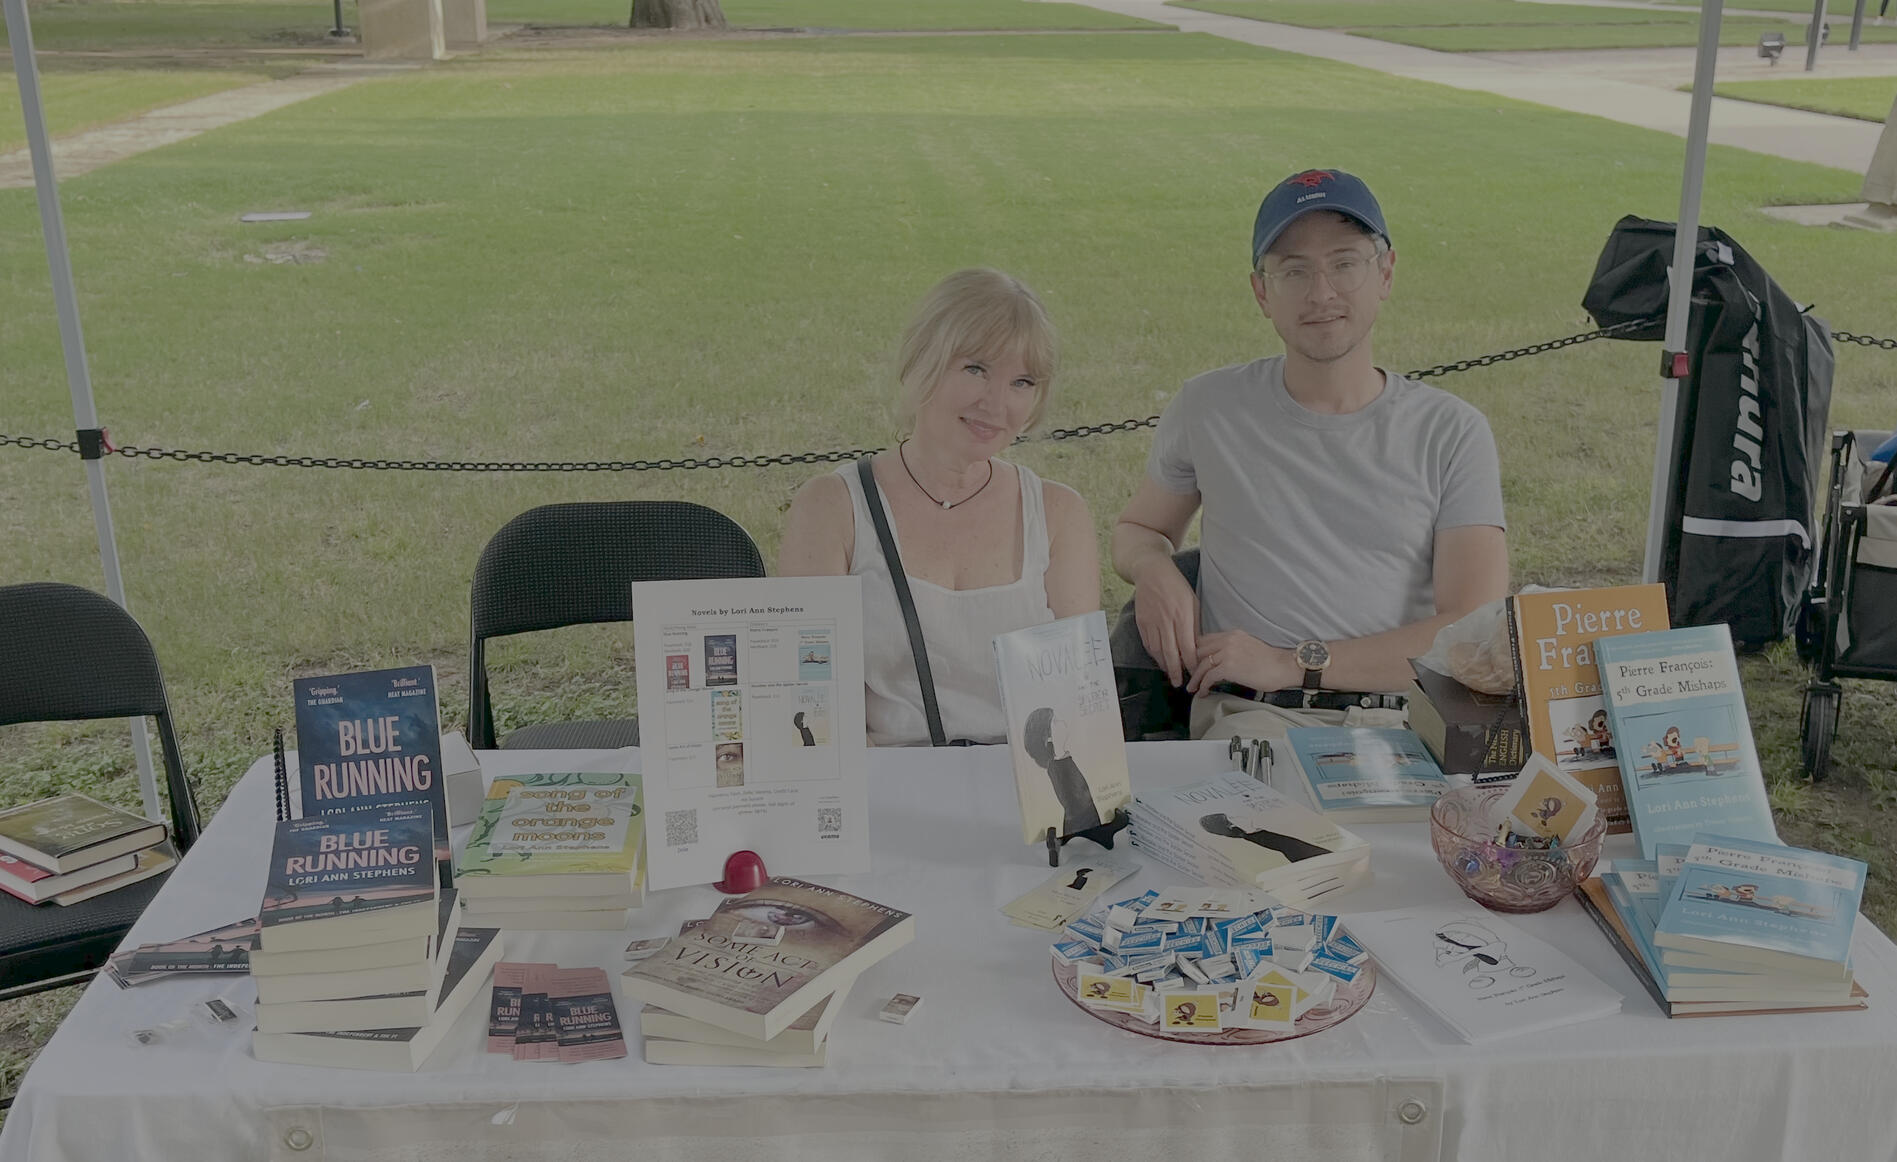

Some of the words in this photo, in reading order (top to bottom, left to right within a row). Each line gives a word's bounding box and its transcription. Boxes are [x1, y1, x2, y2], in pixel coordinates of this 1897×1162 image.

[691, 608, 717, 616] Novels
[719, 608, 728, 617] by
[731, 607, 747, 615] Lori
[767, 606, 804, 615] Stephens
[1552, 603, 1643, 635] Pierre
[1536, 638, 1597, 670] Fra
[1619, 665, 1654, 678] Pierre
[1659, 658, 1713, 674] François:
[1617, 686, 1631, 701] 5th
[1636, 684, 1673, 697] Grade
[1677, 680, 1728, 694] Mishaps
[338, 715, 402, 757] BLUE
[313, 754, 433, 801] RUNNING
[519, 789, 588, 801] song
[593, 787, 627, 799] of
[1647, 802, 1672, 814] Lori
[1674, 800, 1698, 811] Ann
[1700, 793, 1752, 809] Stephens
[545, 800, 592, 813] the
[511, 817, 616, 829] orange
[319, 829, 390, 853] BLUE
[511, 831, 607, 841] moons
[285, 846, 421, 875] RUNNING
[1707, 847, 1752, 861] Pierre
[1719, 859, 1768, 872] Grade
[288, 875, 318, 886] LORI
[321, 872, 349, 882] ANN
[353, 867, 416, 880] STEPHENS
[773, 877, 804, 889] LORI
[808, 886, 833, 897] ANN
[840, 894, 903, 919] STEPHENS
[1681, 907, 1713, 919] Lori
[1717, 913, 1749, 925] Ann
[1753, 919, 1828, 937] Stephens
[694, 931, 759, 954] SOME
[675, 946, 796, 989] VISION
[560, 1012, 612, 1026] RUNNING
[570, 1005, 598, 1016] BLUE
